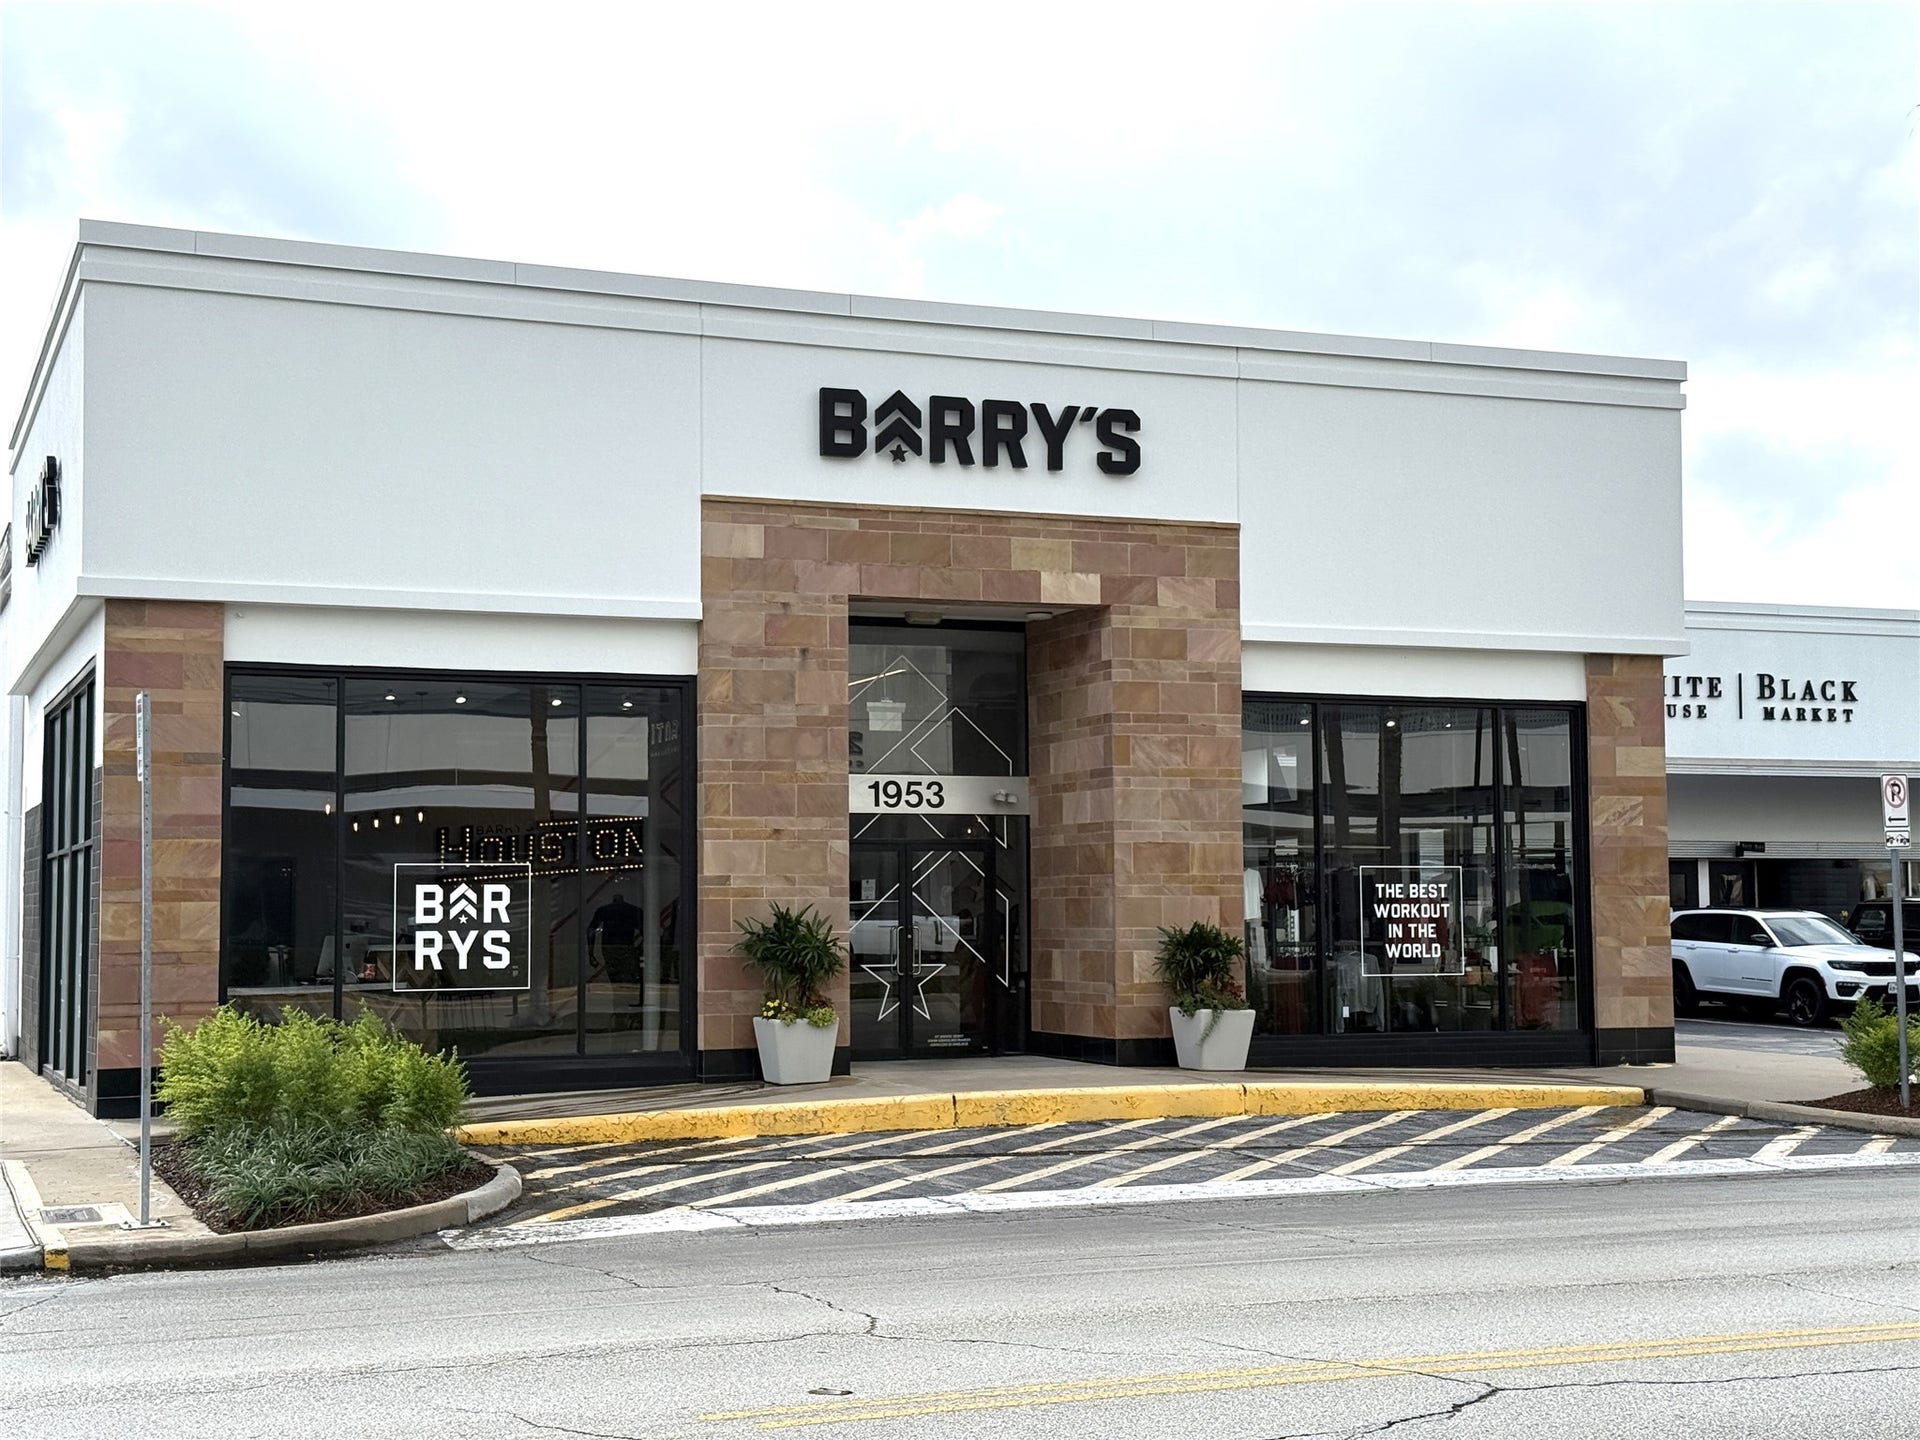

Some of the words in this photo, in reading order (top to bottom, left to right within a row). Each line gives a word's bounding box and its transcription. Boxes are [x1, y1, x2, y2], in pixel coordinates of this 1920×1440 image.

[818, 386, 1141, 476] BARRY'S
[1663, 675, 1722, 699] ITE
[1756, 673, 1859, 702] BLACK
[1762, 706, 1854, 723] MARKET
[868, 780, 945, 808] 1953
[1375, 884, 1404, 898] THE
[1409, 884, 1447, 898] BEST
[1374, 903, 1450, 918] WORKOUT
[1388, 923, 1402, 938] IN
[1408, 923, 1436, 938] THE
[414, 929, 511, 971] RYS
[1385, 943, 1441, 958] WORLD
